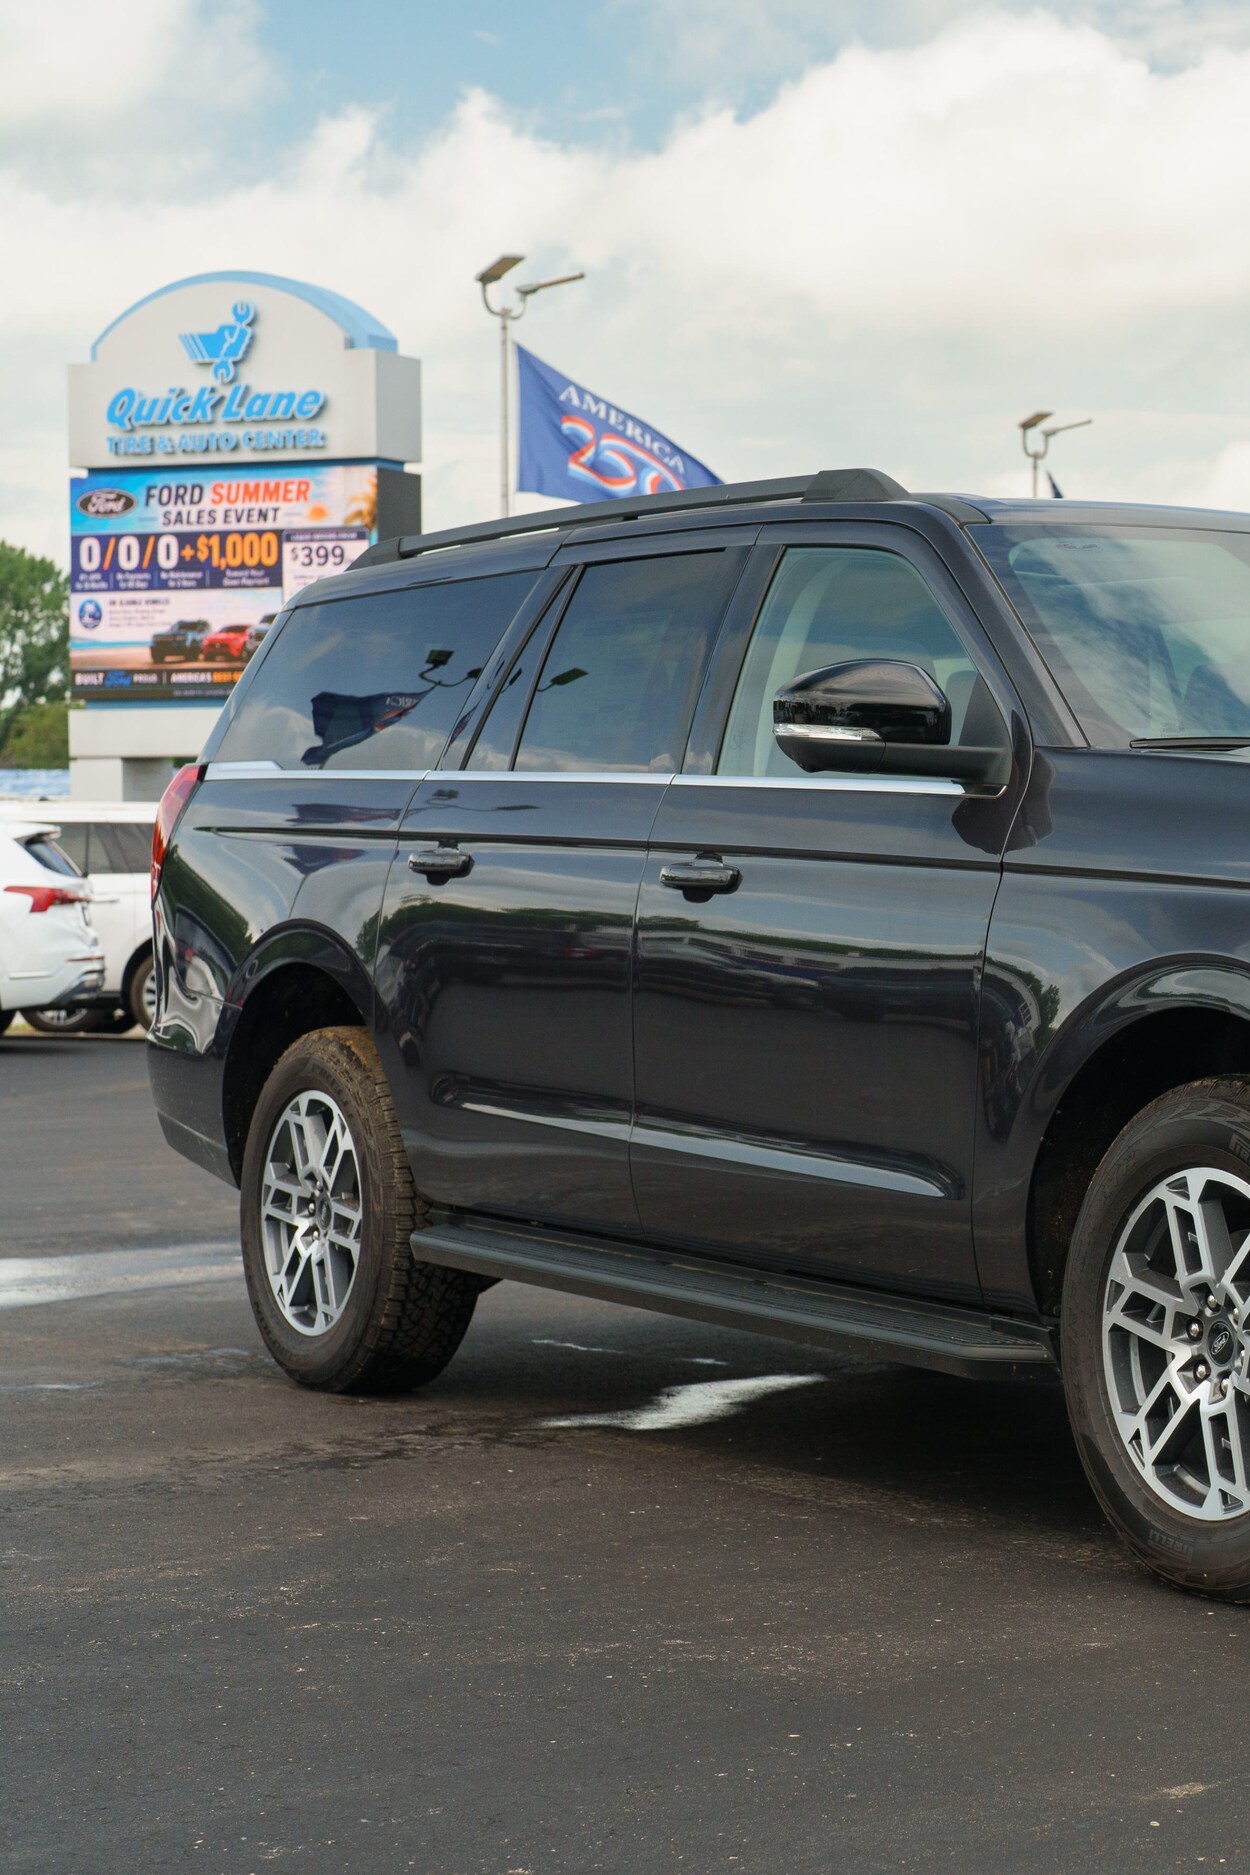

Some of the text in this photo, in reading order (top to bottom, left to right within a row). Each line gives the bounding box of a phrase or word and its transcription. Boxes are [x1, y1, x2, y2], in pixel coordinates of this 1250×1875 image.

[107, 384, 326, 431] Quick Lane
[106, 429, 326, 456] TIRE & AUTO CENTER
[559, 384, 686, 474] AMERICA
[87, 491, 126, 513] Ford
[144, 480, 311, 507] FORD SUMMER
[162, 506, 280, 526] SALES EVENT
[75, 671, 105, 686] BUILT
